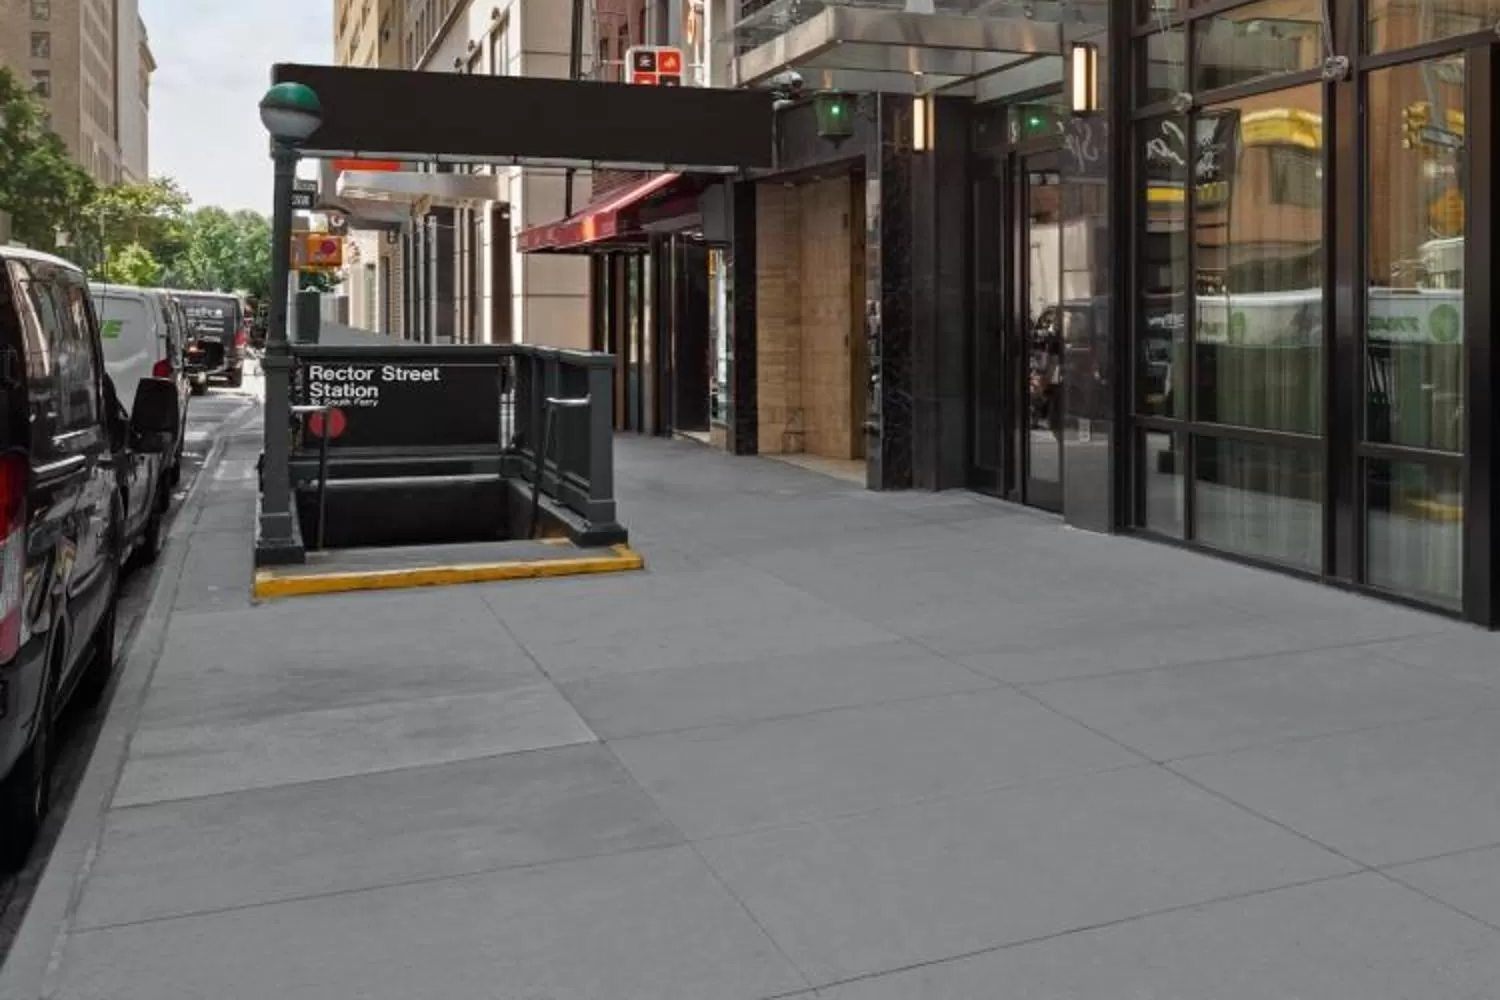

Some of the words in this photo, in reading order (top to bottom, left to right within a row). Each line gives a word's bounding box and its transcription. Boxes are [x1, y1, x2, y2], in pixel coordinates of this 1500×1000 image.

[309, 365, 375, 381] Rector
[381, 365, 440, 381] Street
[309, 381, 379, 398] Station
